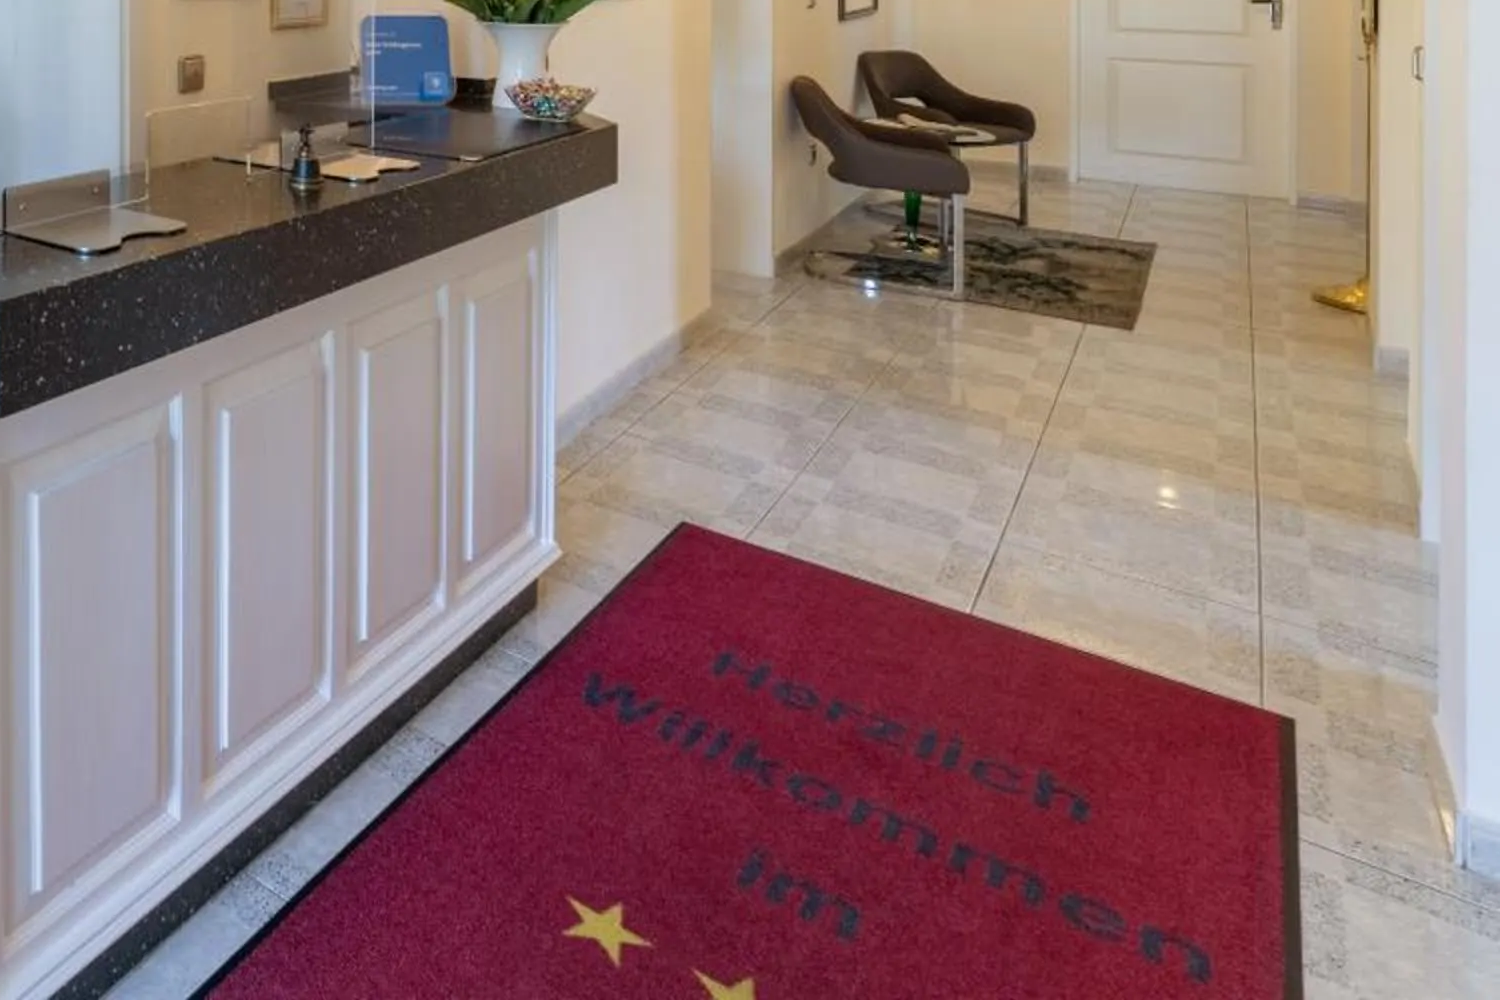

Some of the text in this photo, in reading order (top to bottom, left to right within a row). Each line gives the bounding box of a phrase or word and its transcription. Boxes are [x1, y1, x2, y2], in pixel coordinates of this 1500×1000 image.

[710, 650, 1091, 824] Herzlich
[583, 672, 1212, 984] Willkommen
[736, 848, 861, 942] im
